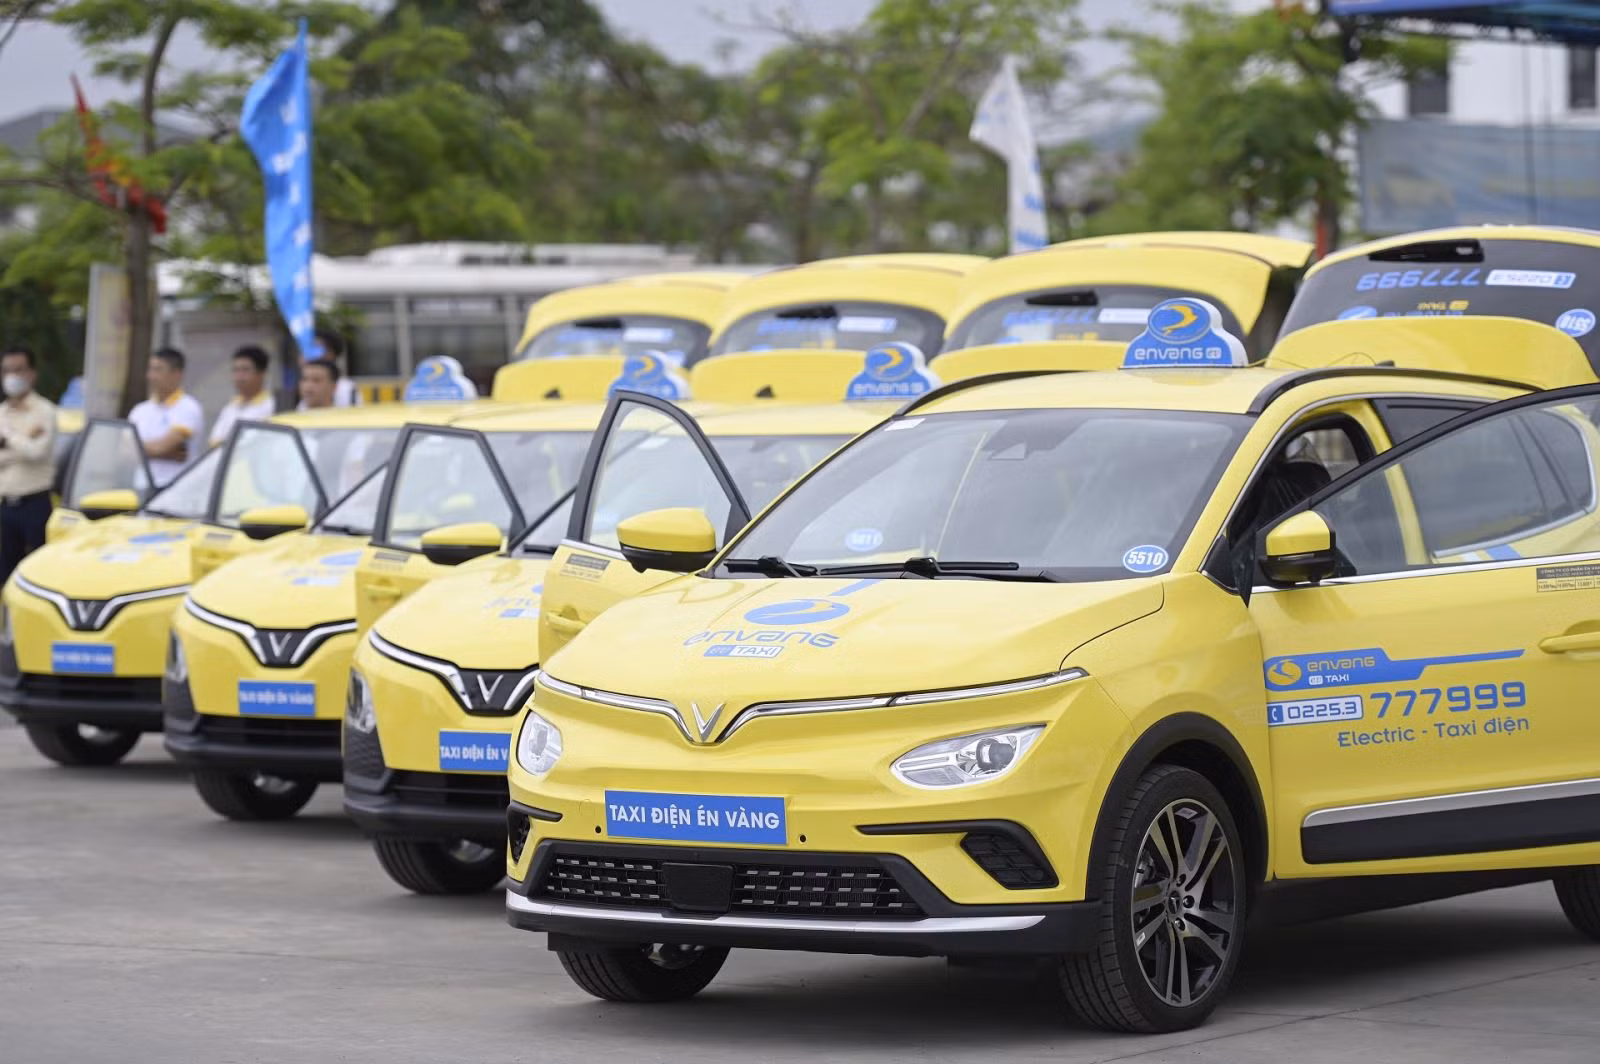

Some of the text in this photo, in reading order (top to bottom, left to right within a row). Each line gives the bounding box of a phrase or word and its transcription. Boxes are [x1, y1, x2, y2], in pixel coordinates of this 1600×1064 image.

[1356, 268, 1480, 290] 777999
[1127, 551, 1163, 566] 5510
[736, 646, 779, 656] TAXI
[1325, 674, 1350, 683] TAXI
[1287, 681, 1527, 719] 0225.3 777999
[1337, 725, 1416, 748] Electric
[1433, 719, 1477, 738] Taxi
[1483, 716, 1530, 736] điện
[440, 745, 461, 759] TAXI
[462, 744, 484, 762] ĐIỆN
[486, 744, 499, 760] ÉN
[609, 803, 780, 830] TAXI ĐIỆN ÉN VÀNG
